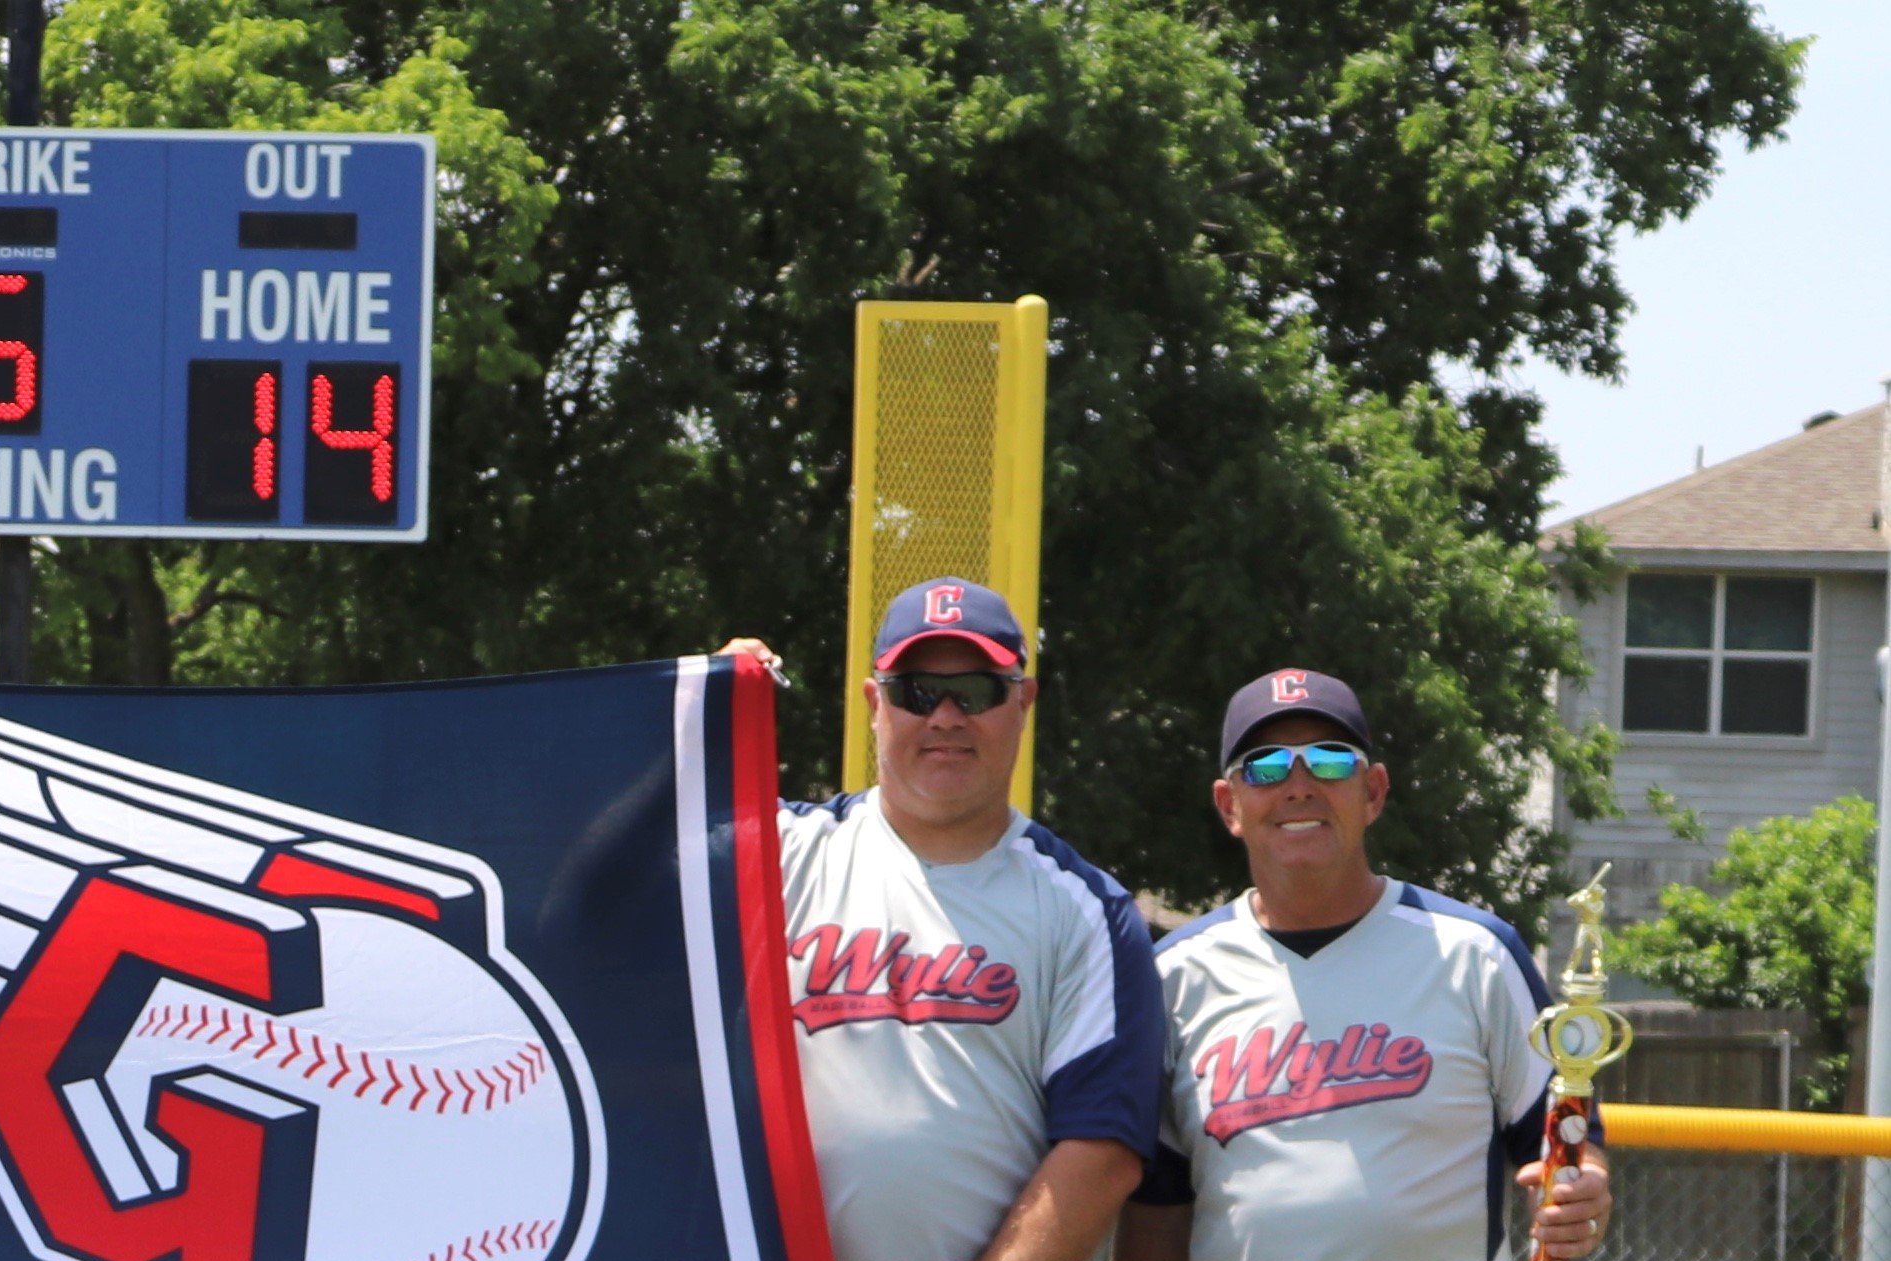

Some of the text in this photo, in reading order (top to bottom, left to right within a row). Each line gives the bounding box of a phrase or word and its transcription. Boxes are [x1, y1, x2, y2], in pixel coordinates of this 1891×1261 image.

[245, 143, 353, 199] OUT
[201, 269, 392, 343] HOME
[253, 371, 395, 503] 14
[924, 584, 965, 625] C
[1272, 669, 1308, 704] C
[790, 923, 1018, 1006] Wylie
[1194, 1021, 1431, 1108] Wylie
